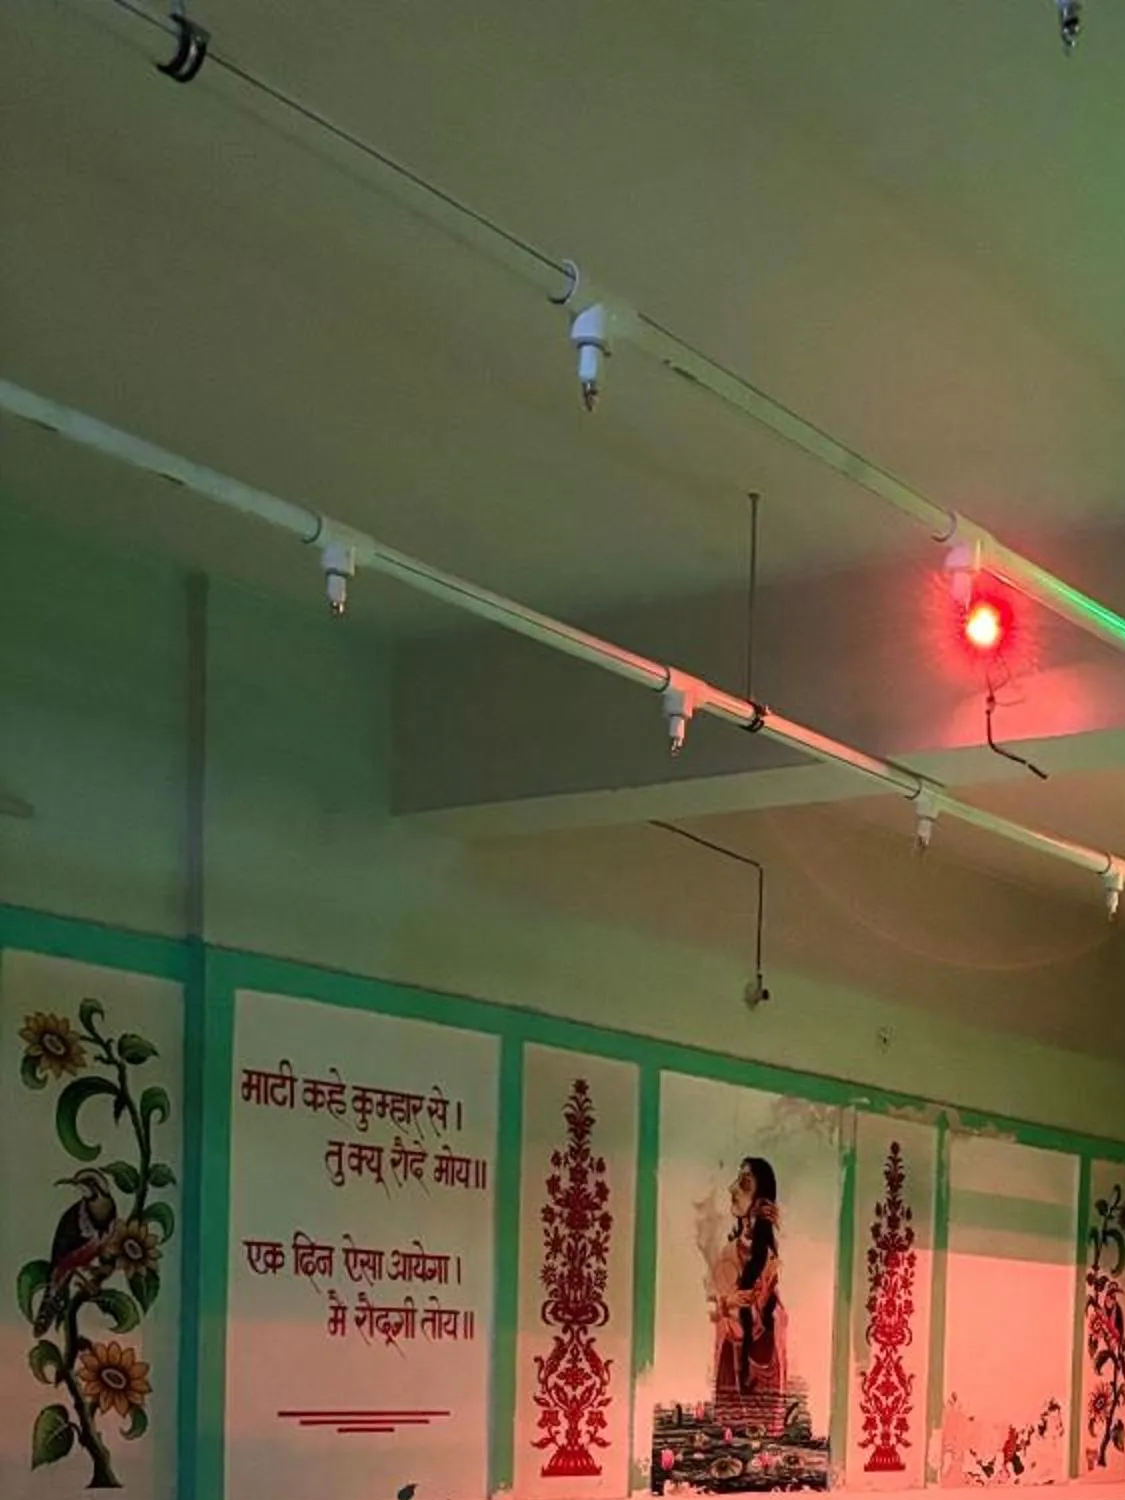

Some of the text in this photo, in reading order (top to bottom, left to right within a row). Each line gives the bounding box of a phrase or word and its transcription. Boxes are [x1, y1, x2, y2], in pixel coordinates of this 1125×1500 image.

[241, 1059, 297, 1109] माटी
[302, 1067, 347, 1119] कहे
[352, 1085, 424, 1140] कुम्हार
[243, 1240, 285, 1275] एक
[342, 1234, 384, 1286] ऐसा
